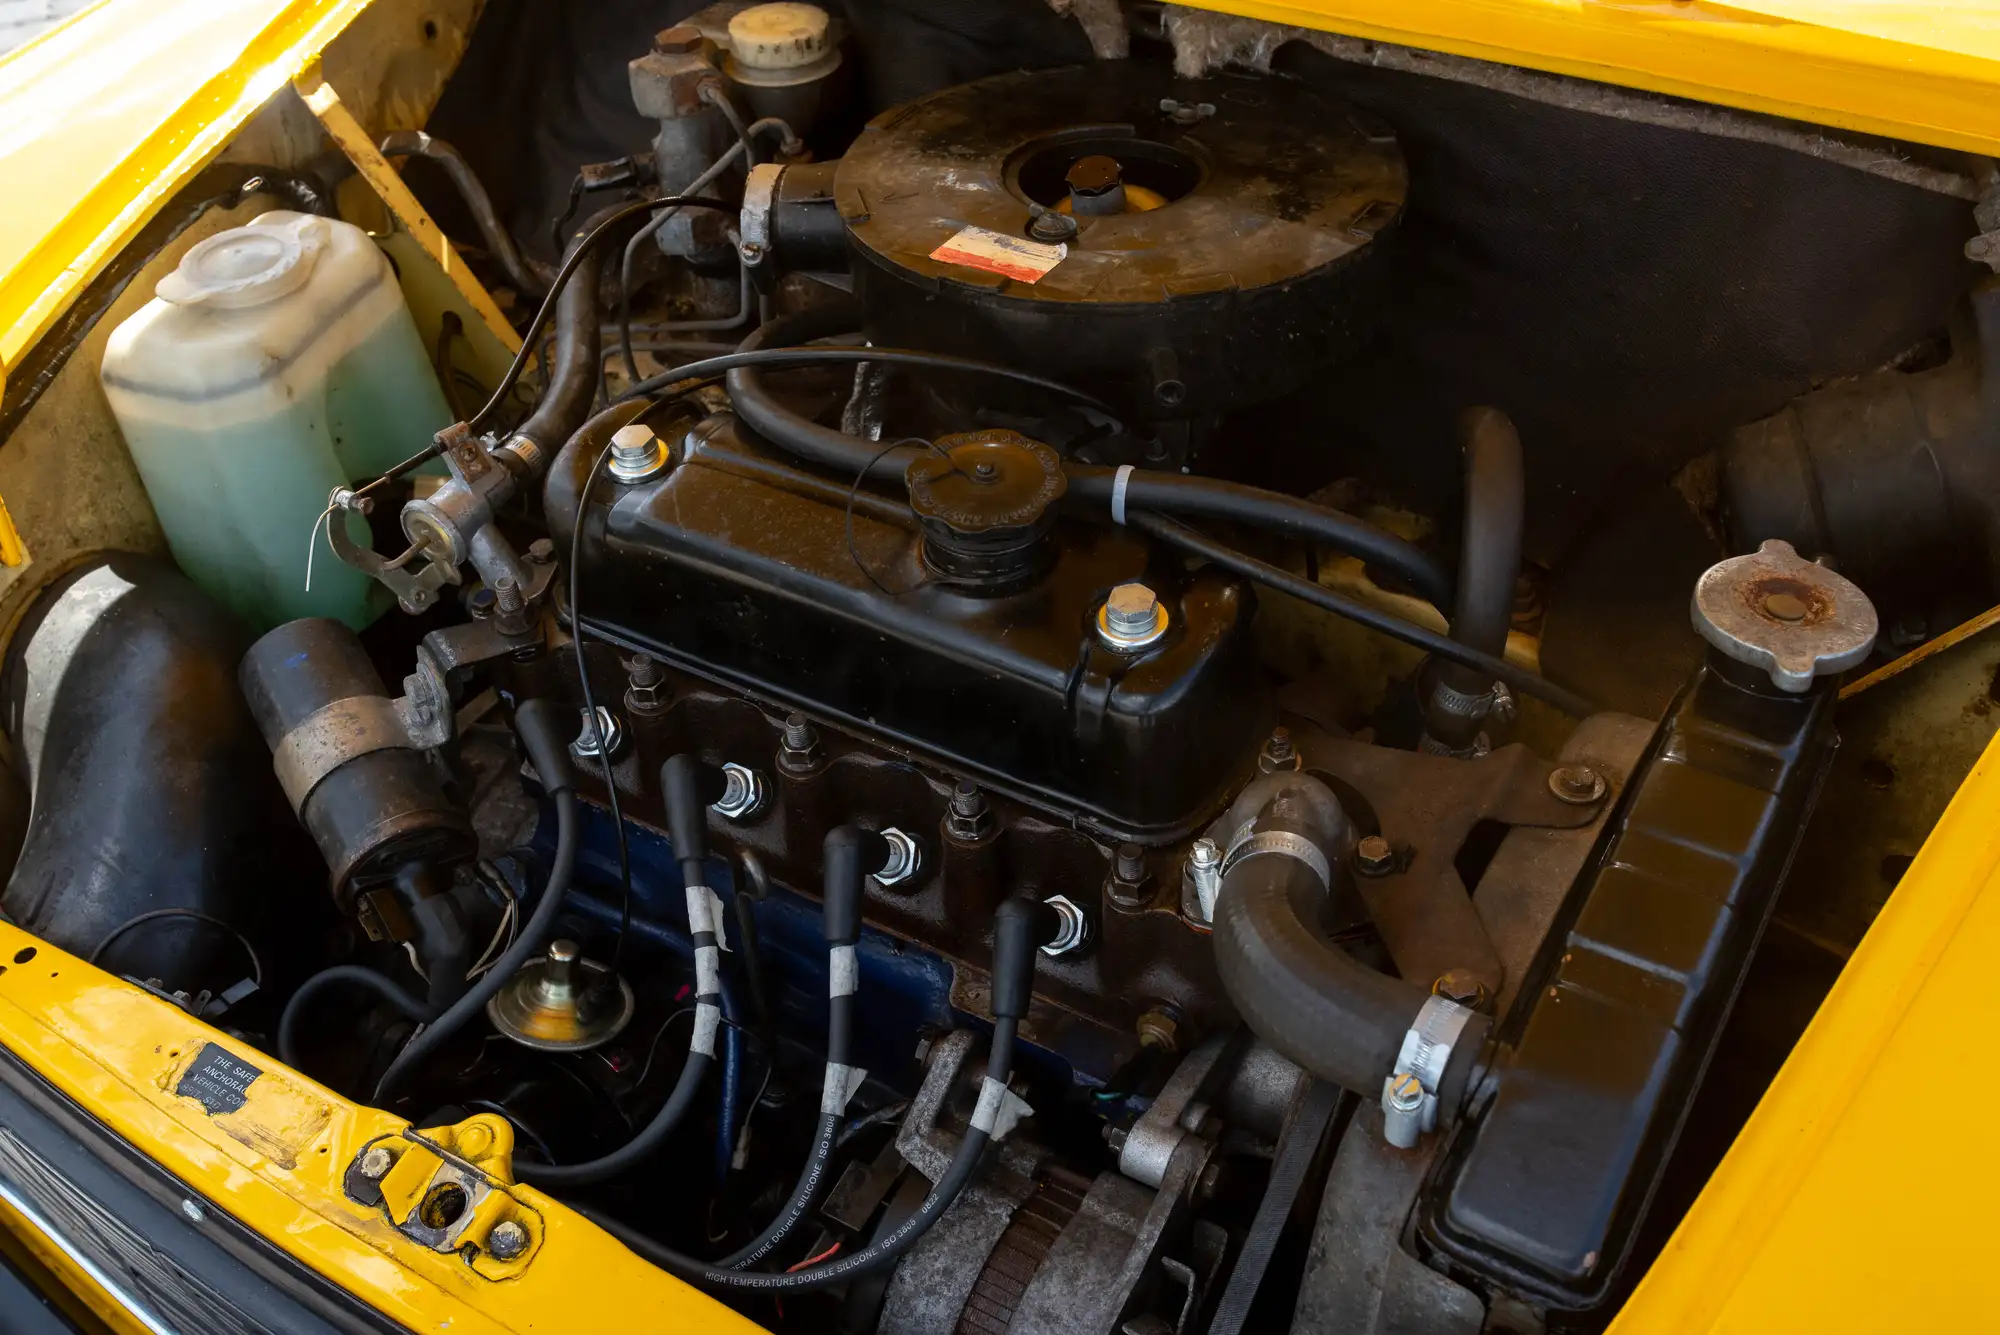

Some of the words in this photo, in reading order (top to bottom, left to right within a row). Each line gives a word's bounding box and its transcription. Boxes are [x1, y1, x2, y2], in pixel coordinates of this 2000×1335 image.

[213, 1055, 233, 1070] THE
[232, 1067, 256, 1083] SAFE
[193, 1073, 228, 1097] VEHICLE
[823, 1115, 836, 1140] 3808
[818, 1140, 830, 1160] ISO
[797, 1163, 823, 1209] SILICONE
[771, 1208, 801, 1244] DOUBLE
[704, 1271, 727, 1284] HIGH
[728, 1276, 796, 1288] TEMPERATURE
[797, 1266, 835, 1284] DOUBLE
[836, 1247, 879, 1274] SILICONE
[880, 1234, 897, 1250] ISO
[921, 1193, 939, 1214] 0822
